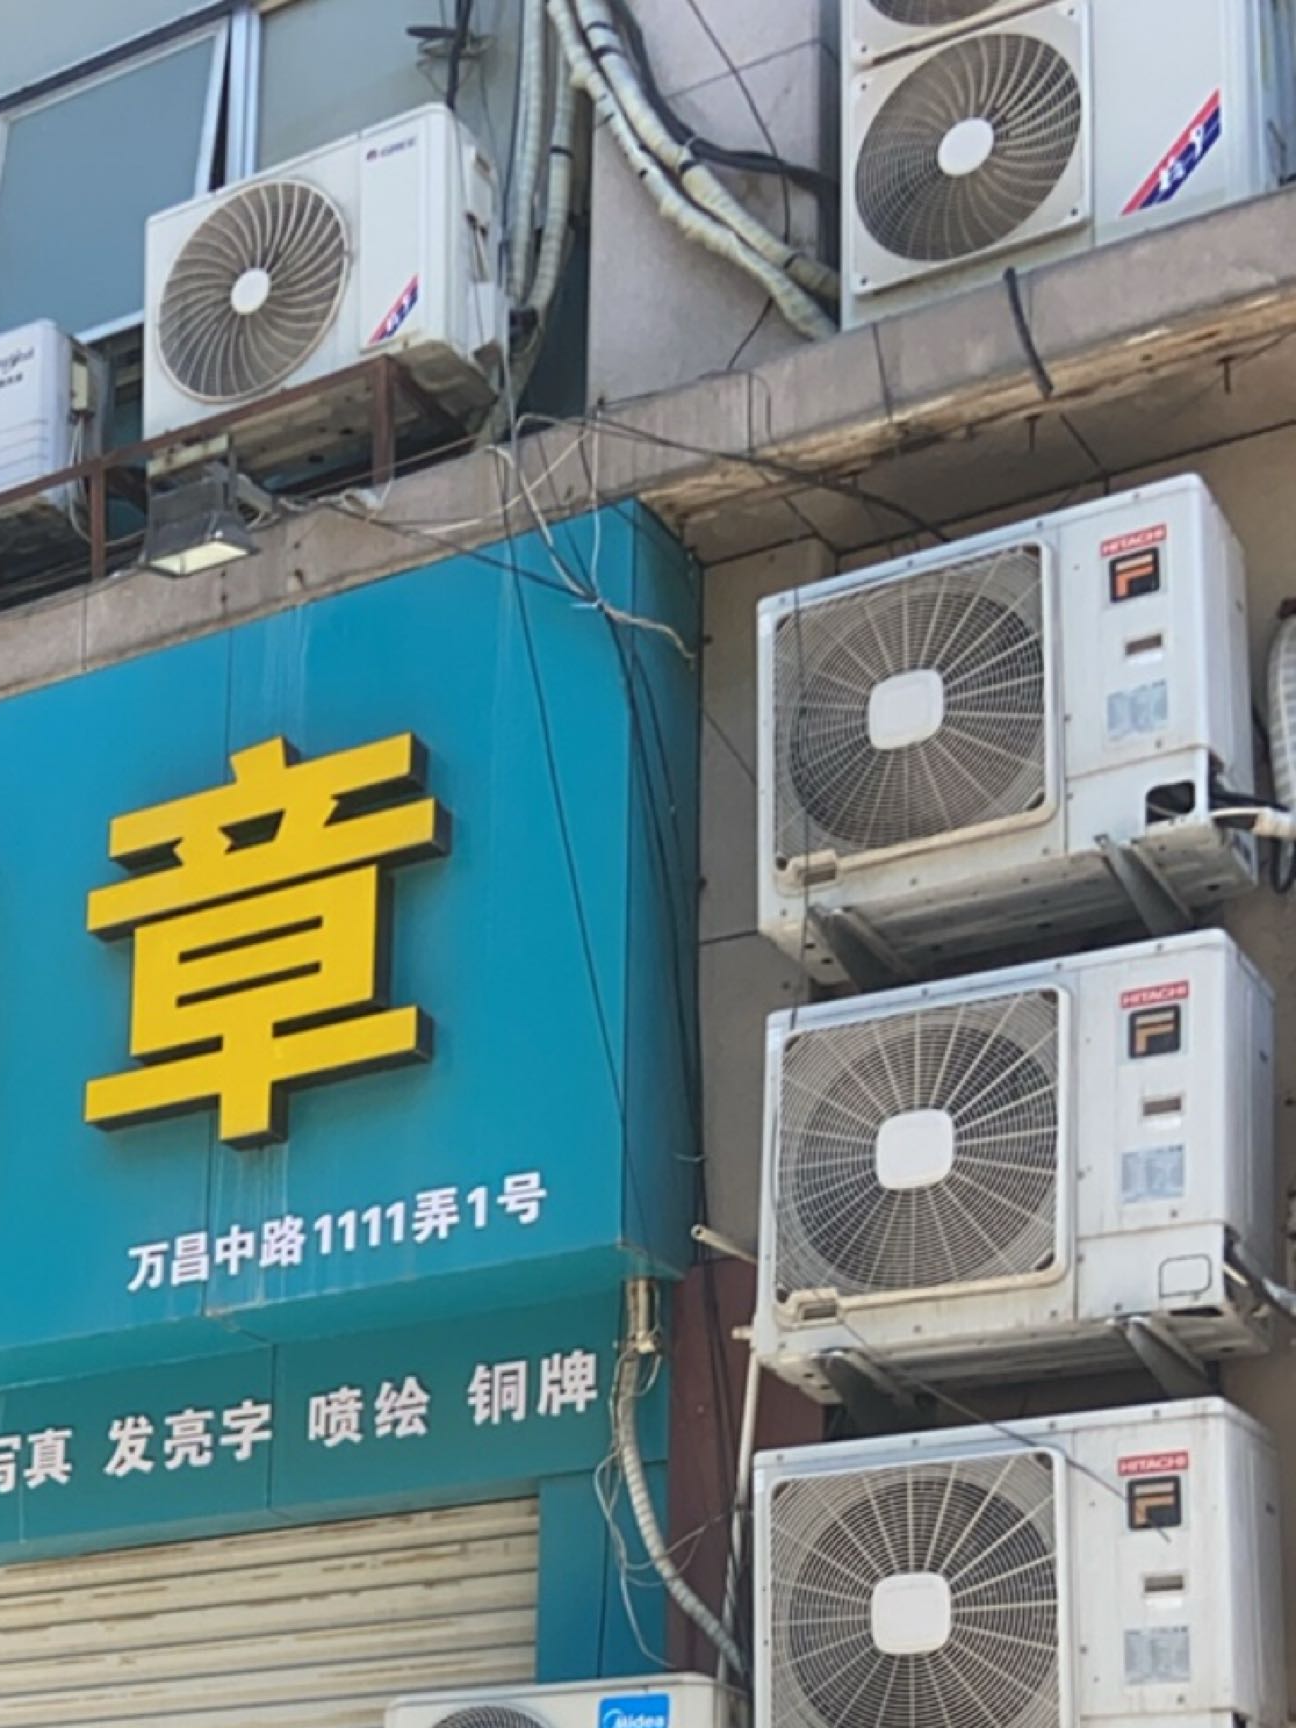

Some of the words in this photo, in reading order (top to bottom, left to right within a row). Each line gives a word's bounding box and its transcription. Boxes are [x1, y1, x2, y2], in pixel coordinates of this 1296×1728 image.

[1122, 984, 1187, 1006] HITACHI
[127, 1170, 549, 1293] 万昌中路1111弄1号
[105, 1398, 274, 1477] 发亮字
[308, 1374, 431, 1449] 喷绘
[468, 1346, 600, 1427] 铜牌
[1120, 1455, 1186, 1473] HITACHI
